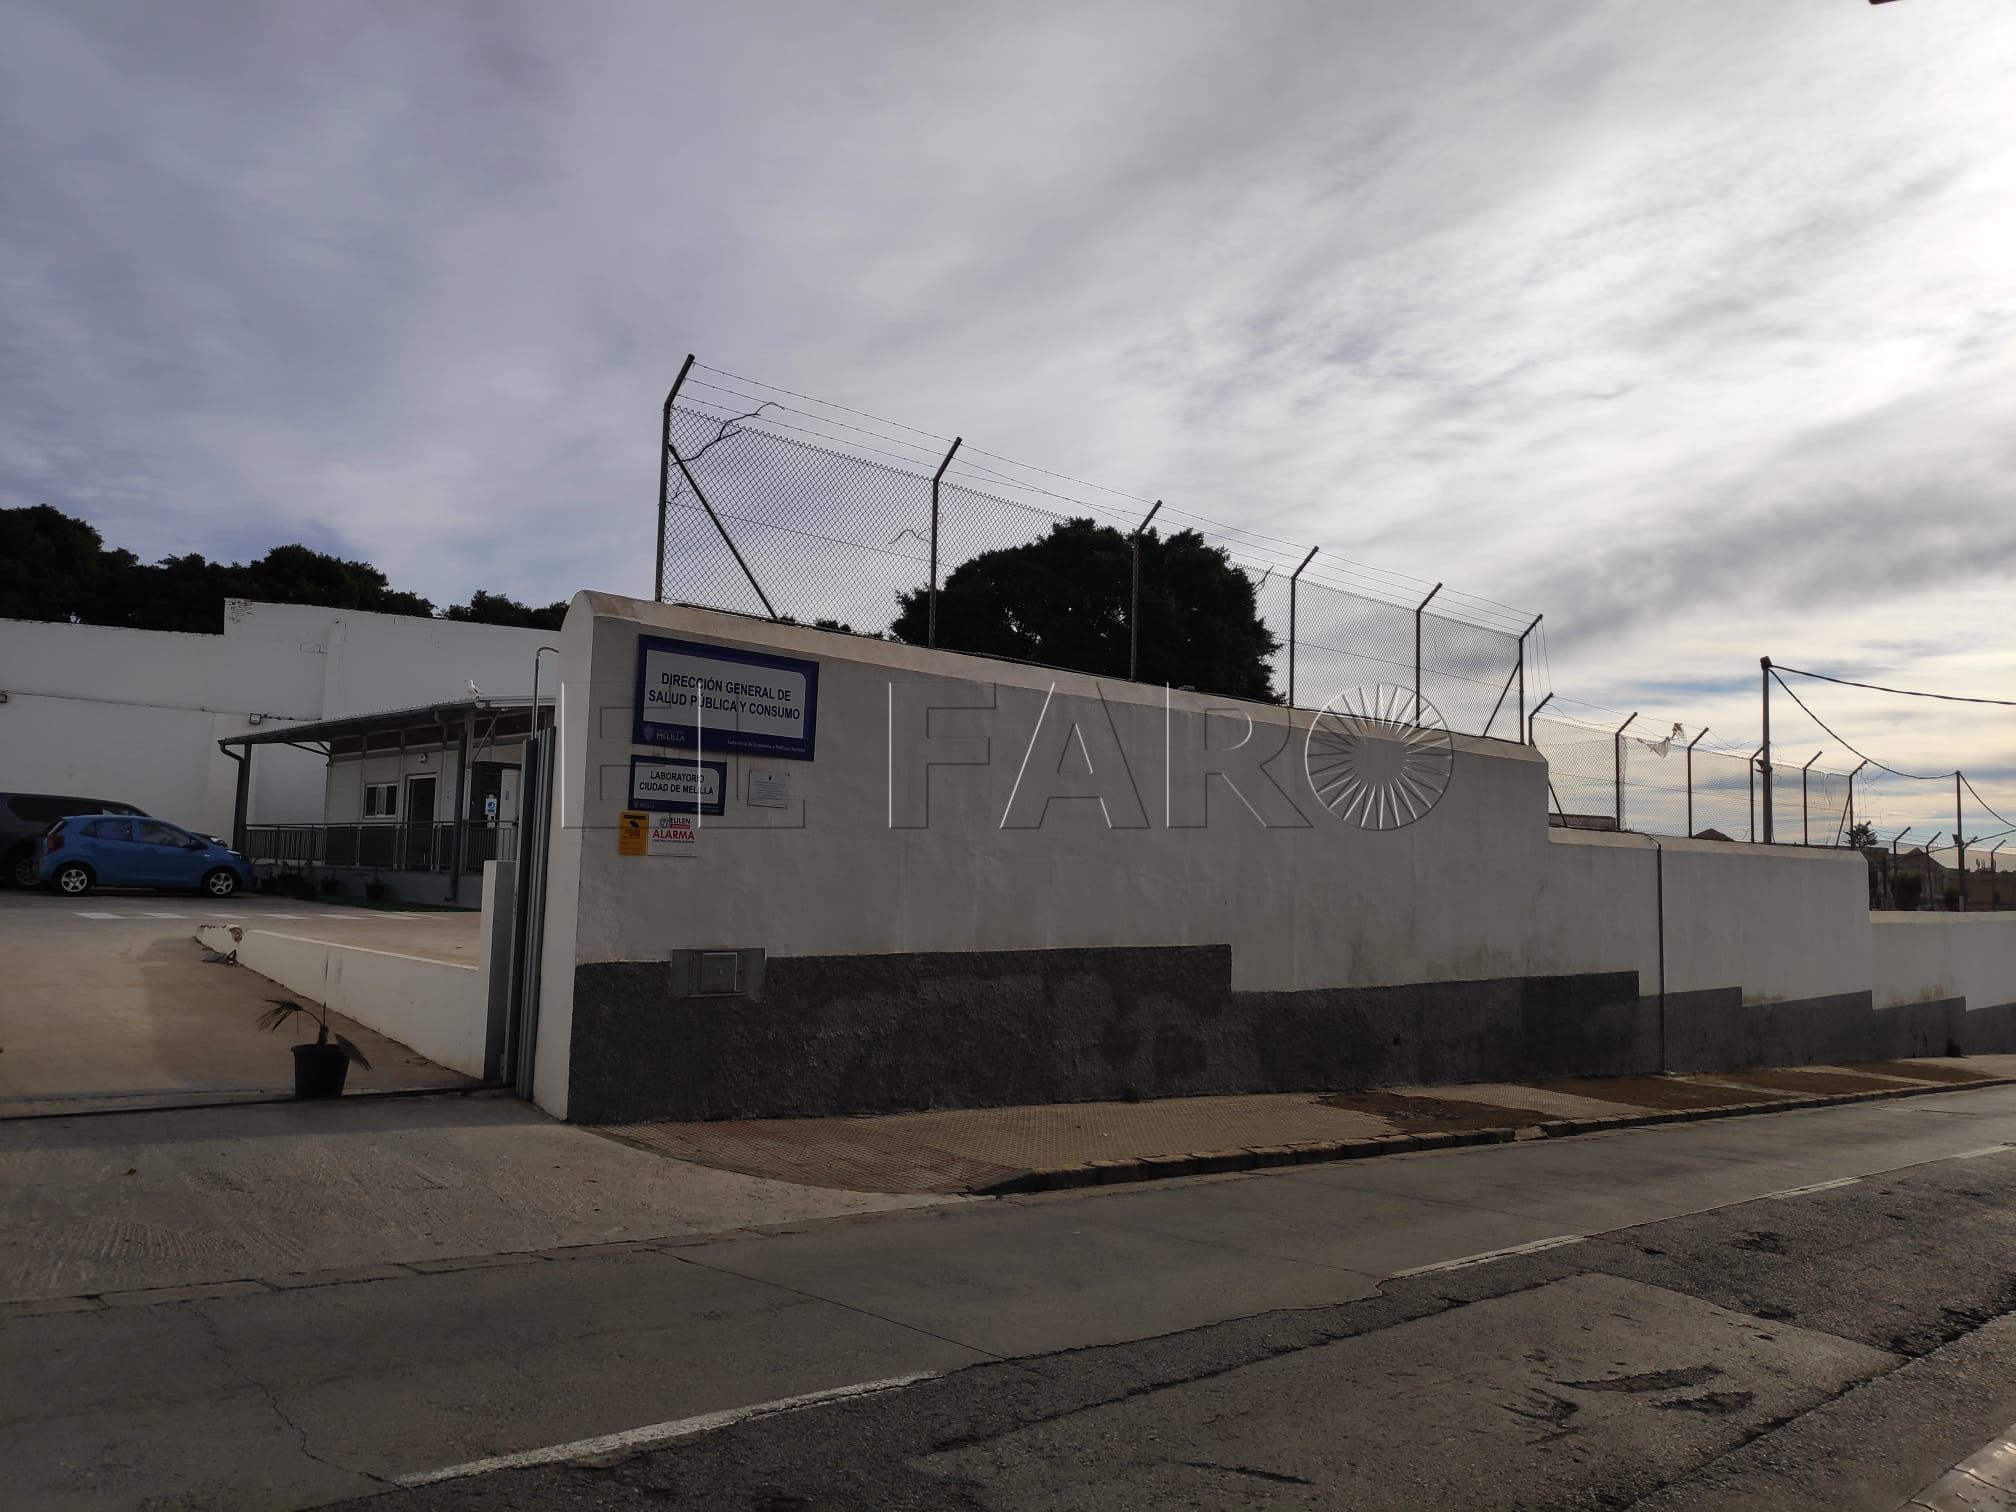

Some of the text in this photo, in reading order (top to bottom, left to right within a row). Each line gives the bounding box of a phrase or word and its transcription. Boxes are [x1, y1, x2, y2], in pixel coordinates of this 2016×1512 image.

[661, 672, 791, 702] DIRECCIÓN GENERAL DE
[648, 690, 800, 720] SALUD PÚBLICA Y CONSUMO
[650, 771, 704, 783] LABORATORIO
[639, 781, 714, 796] CIUDAD DE MELLLA
[652, 829, 695, 841] ALARMA
